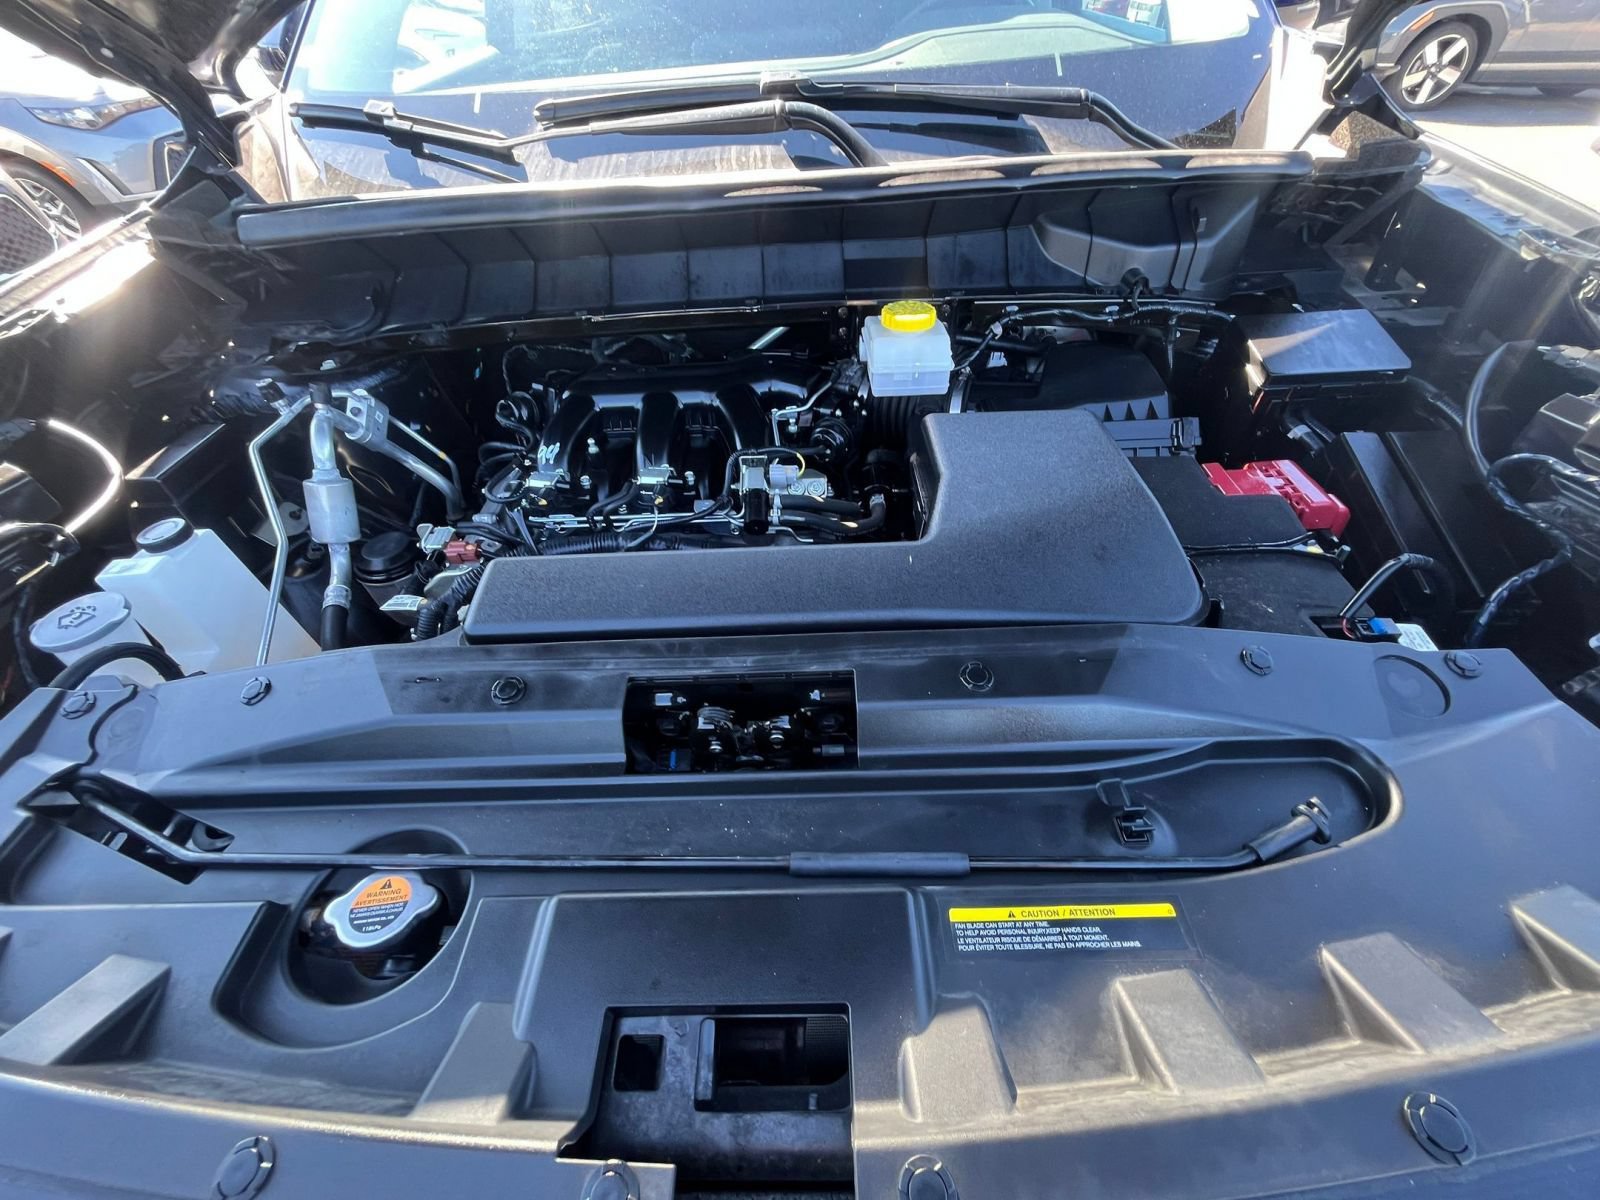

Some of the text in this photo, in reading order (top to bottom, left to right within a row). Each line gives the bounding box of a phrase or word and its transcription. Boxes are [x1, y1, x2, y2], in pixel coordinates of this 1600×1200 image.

[366, 889, 401, 898] WARNING
[355, 895, 407, 905] AVERTISSEMENT
[1021, 909, 1060, 918] CAUTION
[1069, 908, 1116, 917] ATTENTION
[965, 936, 1001, 944] VENTILATEUR
[1031, 934, 1062, 943] DÉMARRER
[975, 943, 994, 951] ÉVITER
[994, 943, 1013, 951] TOUTE
[1075, 941, 1110, 949] APPROCHER
